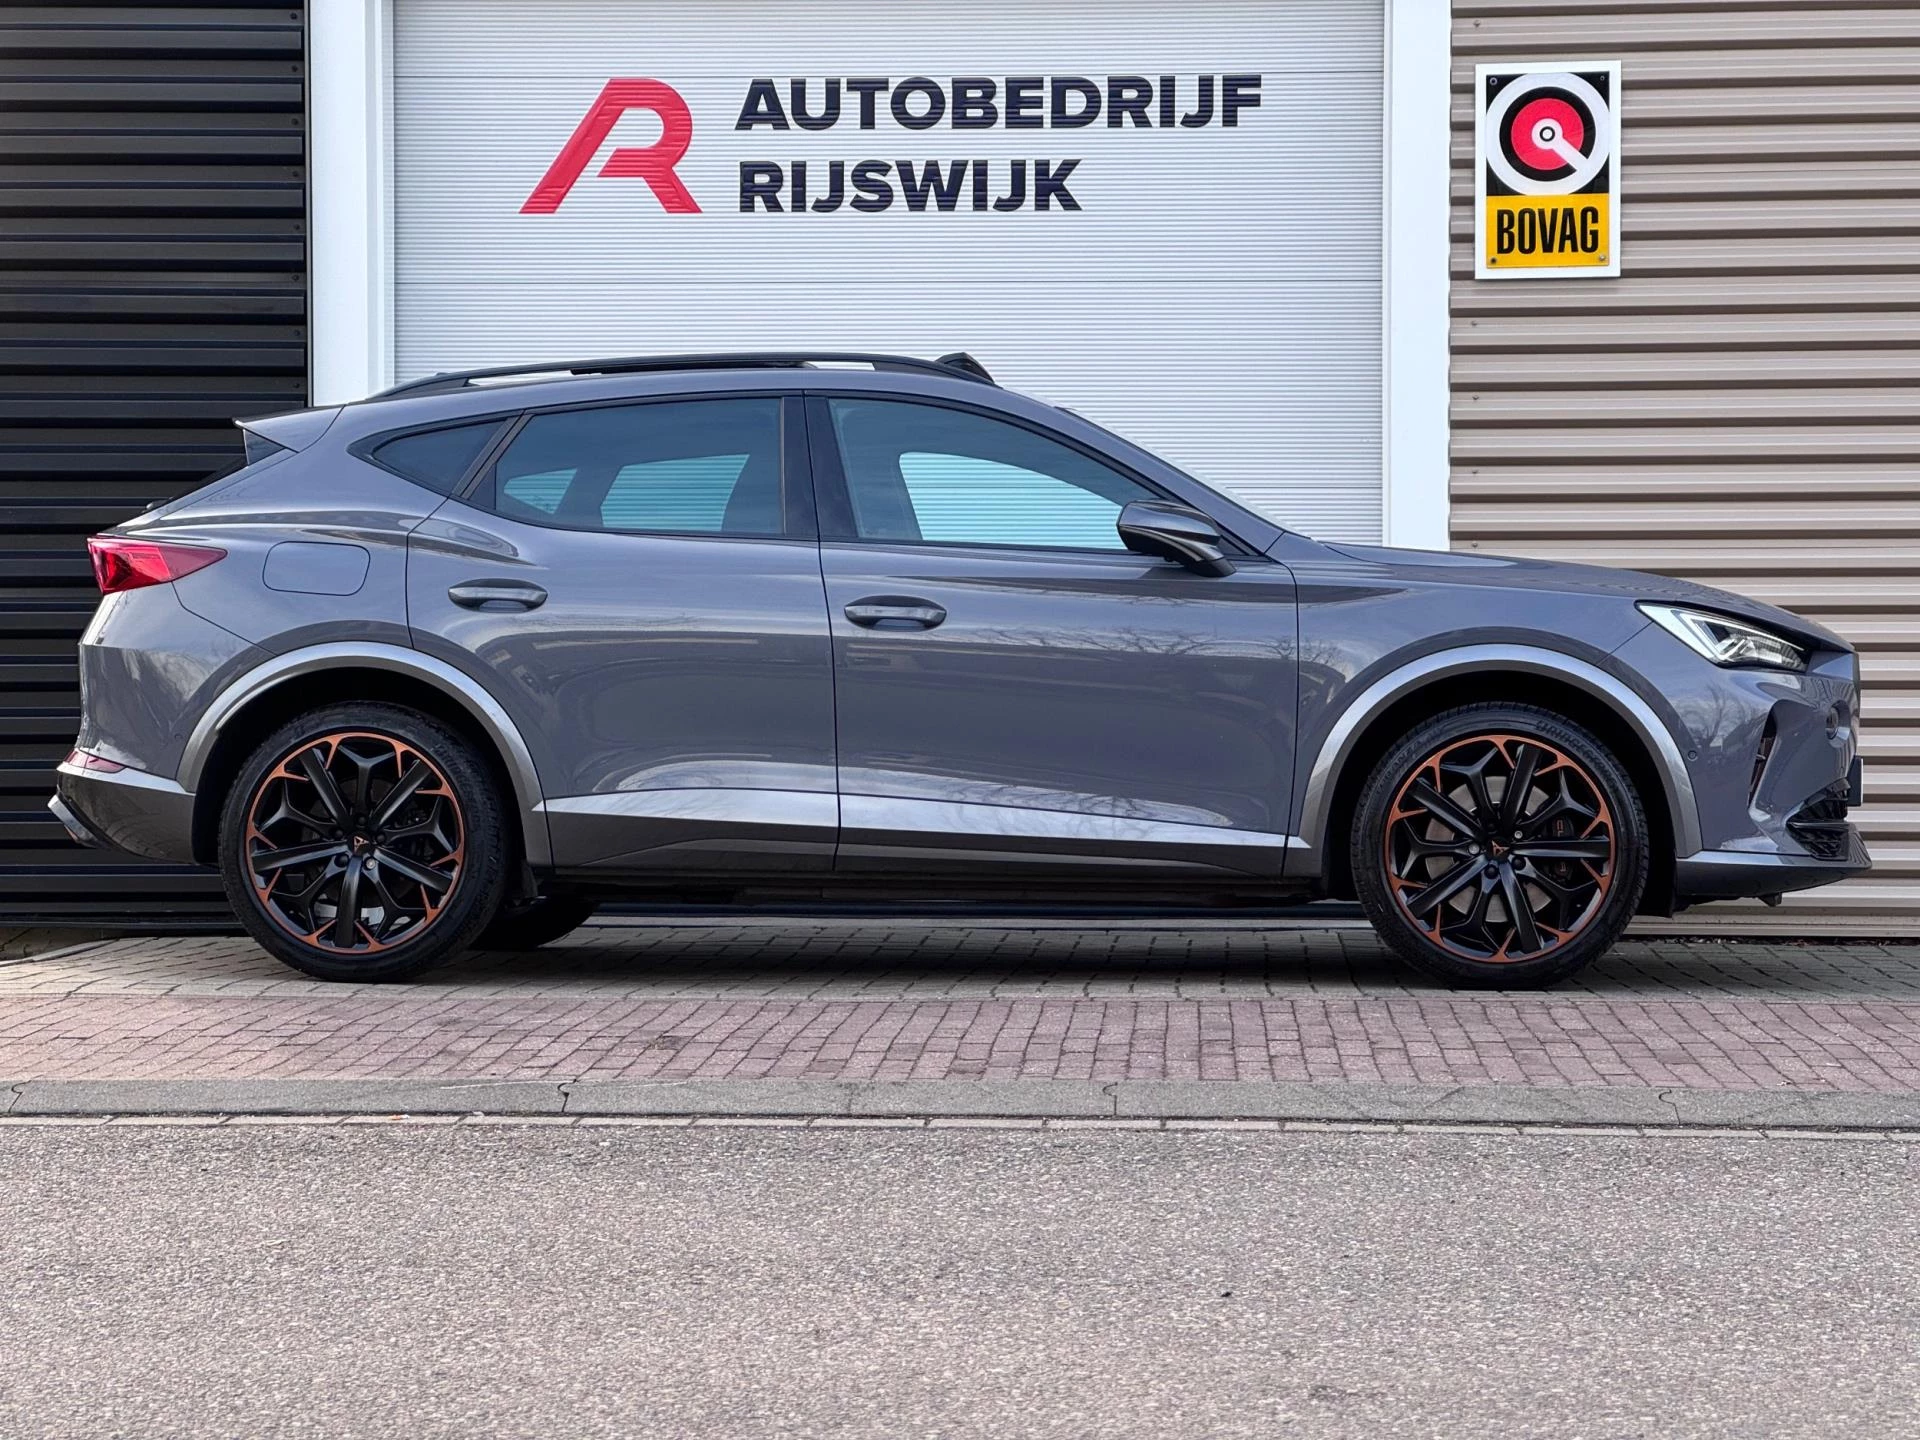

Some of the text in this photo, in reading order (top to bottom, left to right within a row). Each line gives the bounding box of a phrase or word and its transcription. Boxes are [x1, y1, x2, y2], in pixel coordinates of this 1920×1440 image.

[734, 74, 1262, 130] AUTOBEDRIJF
[739, 159, 1082, 212] RIJSWIJK
[1496, 206, 1599, 254] BOVAG
